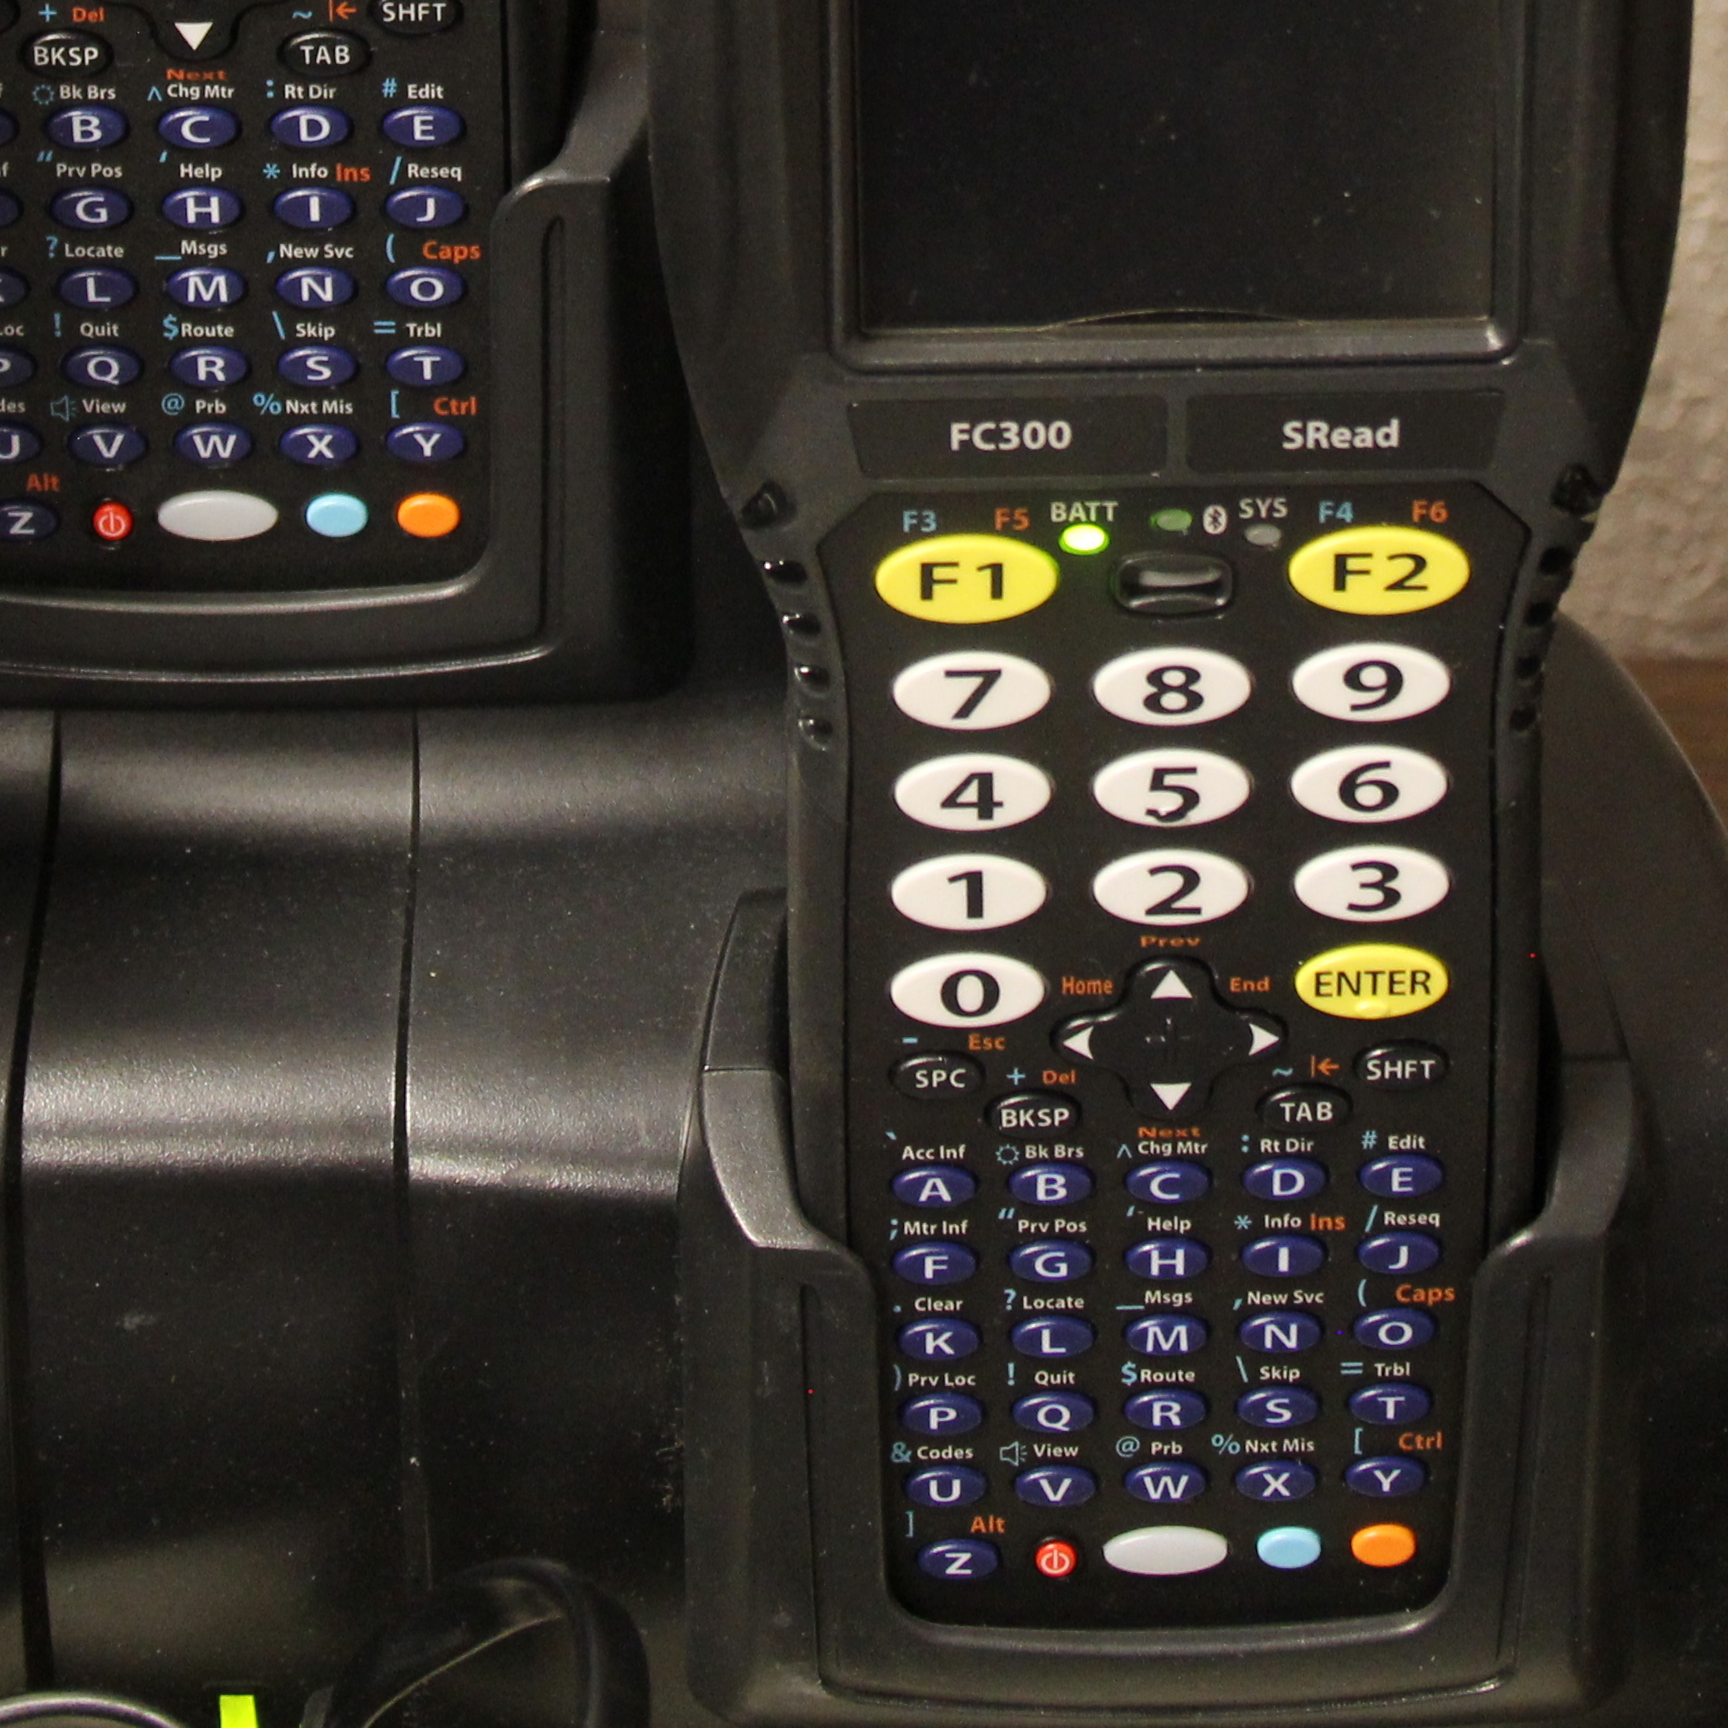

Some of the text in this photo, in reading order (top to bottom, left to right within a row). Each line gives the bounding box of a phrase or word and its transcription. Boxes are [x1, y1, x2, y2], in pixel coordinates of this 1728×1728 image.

[382, 2, 446, 23] SHFT
[33, 45, 99, 66] BKSP
[300, 45, 350, 65] TAB
[179, 163, 223, 182] Help
[407, 163, 462, 182] Reseq
[64, 243, 124, 258] Locate
[180, 239, 228, 259] Msgs
[422, 241, 481, 264] Caps
[181, 322, 234, 338] Route
[950, 420, 1072, 451] FC300
[1282, 418, 1400, 450] SRead
[995, 508, 1030, 531] F5
[1050, 501, 1117, 523] BATT
[1239, 498, 1288, 519] SYS
[1319, 501, 1354, 523] F4
[1412, 501, 1448, 523] F6
[903, 510, 937, 533] F3
[919, 561, 1004, 601] F1
[1333, 552, 1428, 592] F2
[944, 668, 1003, 720] 7
[1142, 664, 1205, 715] 8
[1342, 659, 1404, 712] 9
[940, 771, 1004, 821] 4
[1145, 766, 1201, 824] 5
[1338, 760, 1400, 813] 6
[947, 869, 984, 919] 1
[1144, 864, 1202, 917] 2
[1346, 860, 1402, 913] 3
[940, 968, 1001, 1018] 0
[1062, 977, 1113, 995] Home
[1230, 976, 1270, 993] End
[1314, 969, 1431, 998] ENTER
[915, 1068, 966, 1089] SPC
[1366, 1059, 1436, 1081] SHFT
[1001, 1107, 1070, 1128] BKSP
[1280, 1101, 1333, 1122] TAB
[1310, 1214, 1346, 1231] Ins
[914, 1297, 963, 1312] Clear
[1022, 1295, 1085, 1310] Locate
[1395, 1284, 1455, 1306] Caps
[1374, 1362, 1410, 1377] Trbl
[1398, 1431, 1443, 1451] Ctrl
